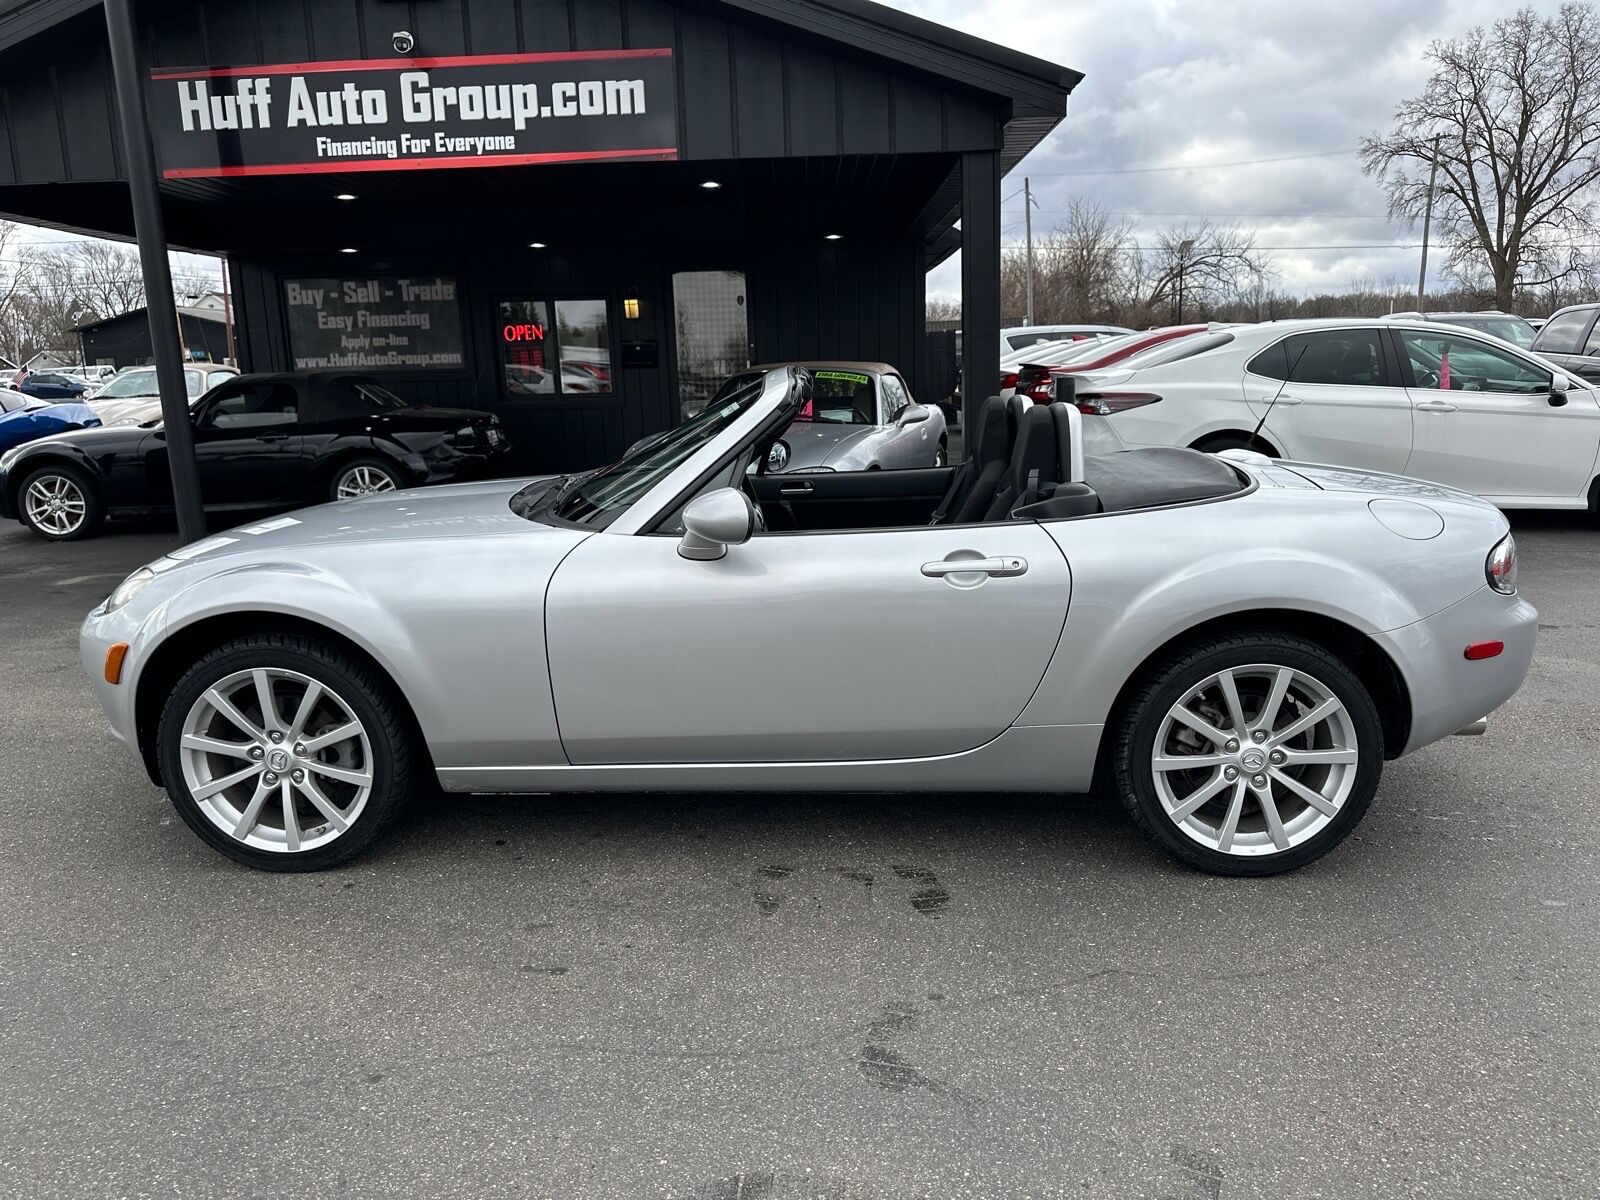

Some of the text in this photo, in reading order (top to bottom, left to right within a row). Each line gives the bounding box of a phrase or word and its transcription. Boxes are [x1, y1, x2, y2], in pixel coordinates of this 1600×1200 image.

[177, 72, 646, 132] Huff Auto Group.com
[316, 132, 516, 158] Financing For Everyone
[287, 283, 324, 309] Buy
[343, 280, 380, 303] Sell
[398, 278, 455, 301] Trade
[317, 310, 430, 331] Easy Financing
[341, 333, 409, 349] Apply on-line
[503, 324, 544, 341] OPEN
[295, 351, 462, 369] www.HuffAutoGroup.com
